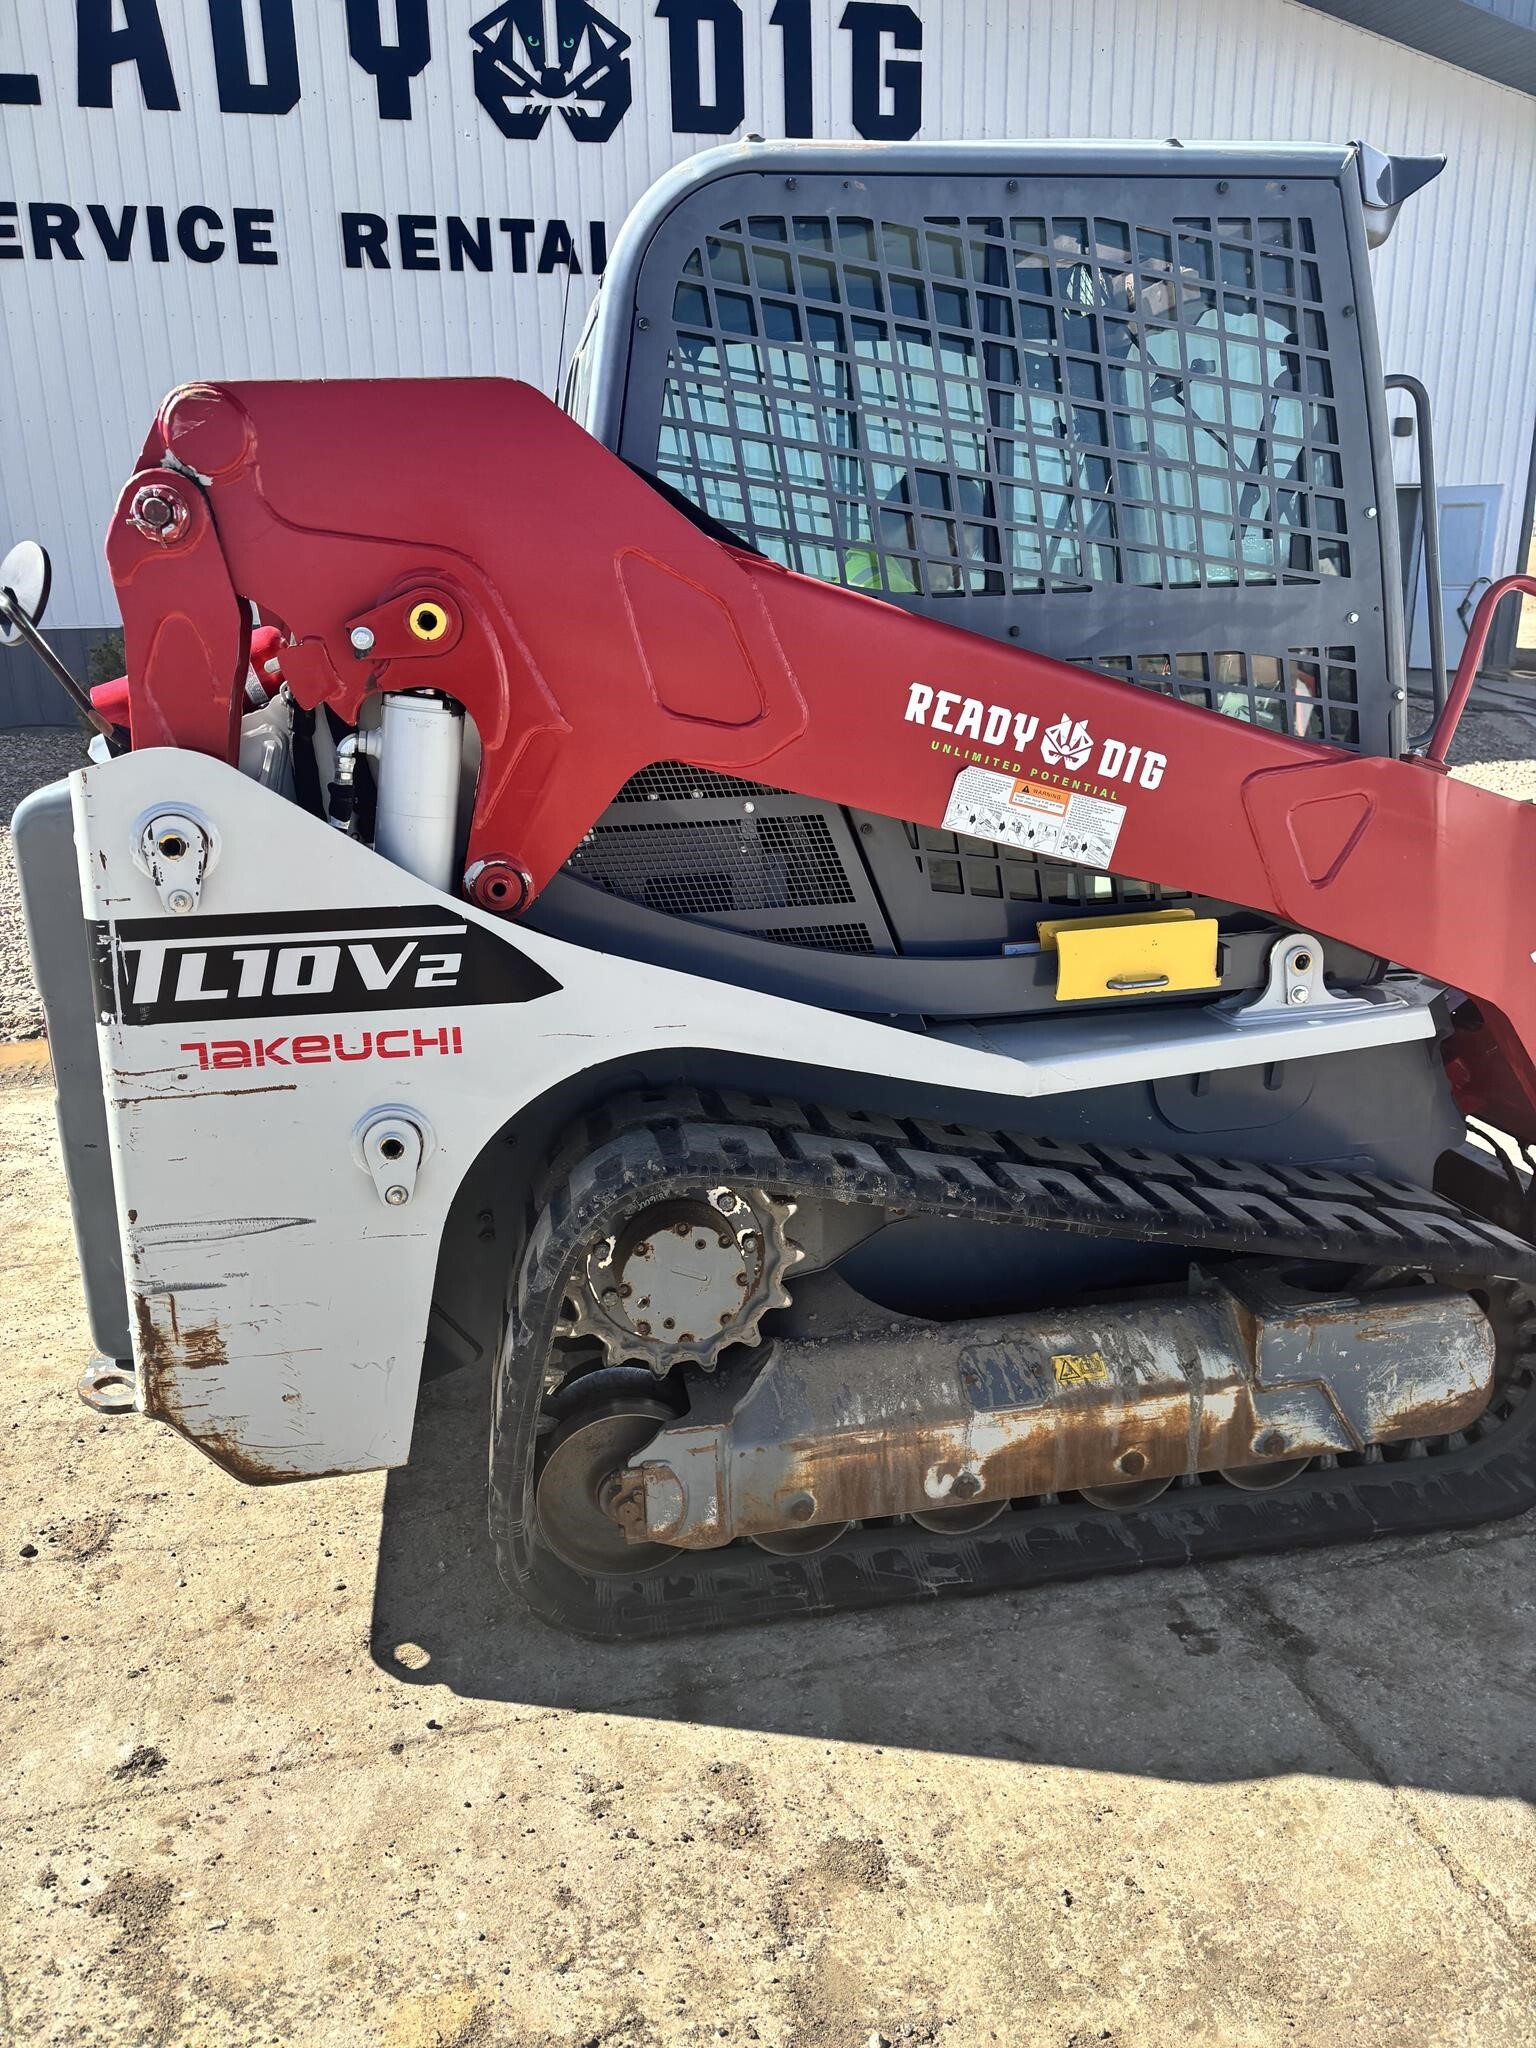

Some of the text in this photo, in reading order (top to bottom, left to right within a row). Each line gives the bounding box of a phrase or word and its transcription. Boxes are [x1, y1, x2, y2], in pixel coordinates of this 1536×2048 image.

[905, 683, 1167, 790] READY DIG
[931, 740, 1021, 772] UNLIMITED
[1030, 768, 1117, 800] POTENTIAL
[1033, 789, 1062, 800] WARNING
[121, 926, 467, 1004] TL10V2
